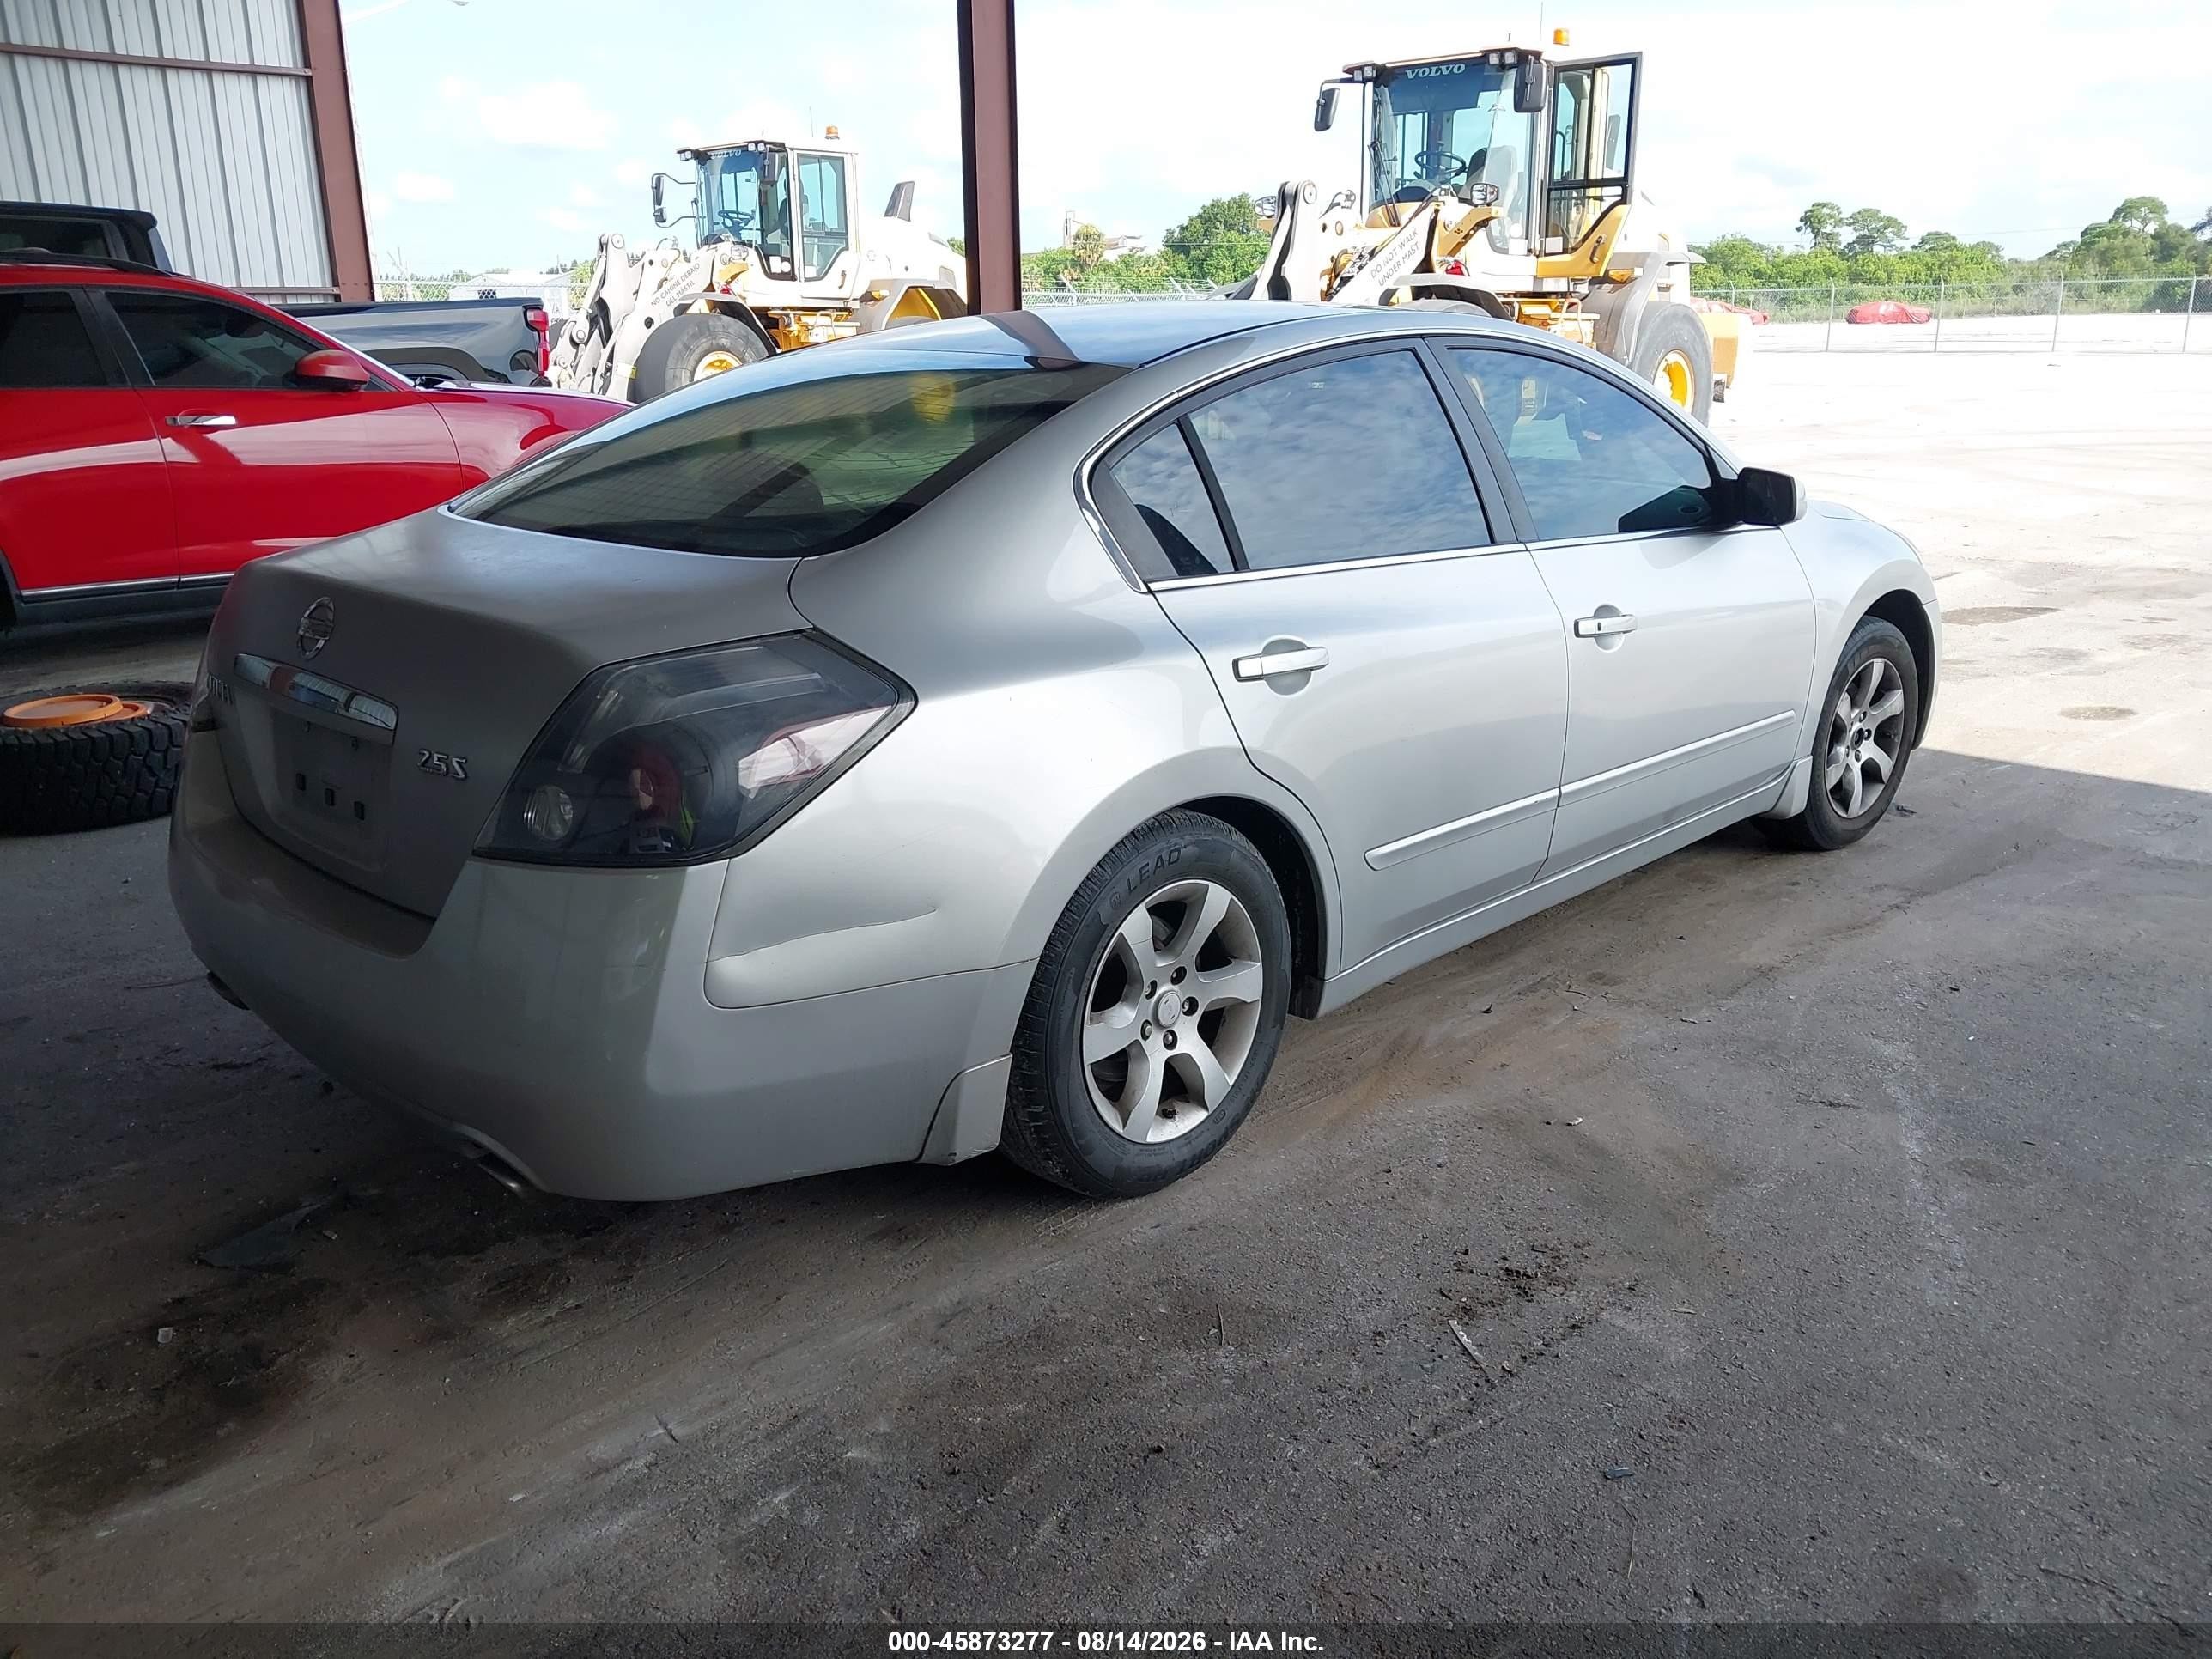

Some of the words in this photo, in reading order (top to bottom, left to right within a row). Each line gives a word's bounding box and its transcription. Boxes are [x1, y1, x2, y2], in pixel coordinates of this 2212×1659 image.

[1405, 63, 1466, 79] VOLVO
[708, 149, 742, 160] VOLVO
[1370, 264, 1382, 279] DO
[1383, 246, 1397, 266] NOT
[1398, 228, 1419, 250] WALK
[1378, 260, 1402, 286] UNDER
[1401, 241, 1419, 264] MAST
[651, 296, 660, 307] NO
[660, 278, 681, 299] CAMINE
[680, 263, 700, 282] DEBAJO
[665, 295, 677, 307] DEL
[1127, 847, 1182, 892] LEAD
